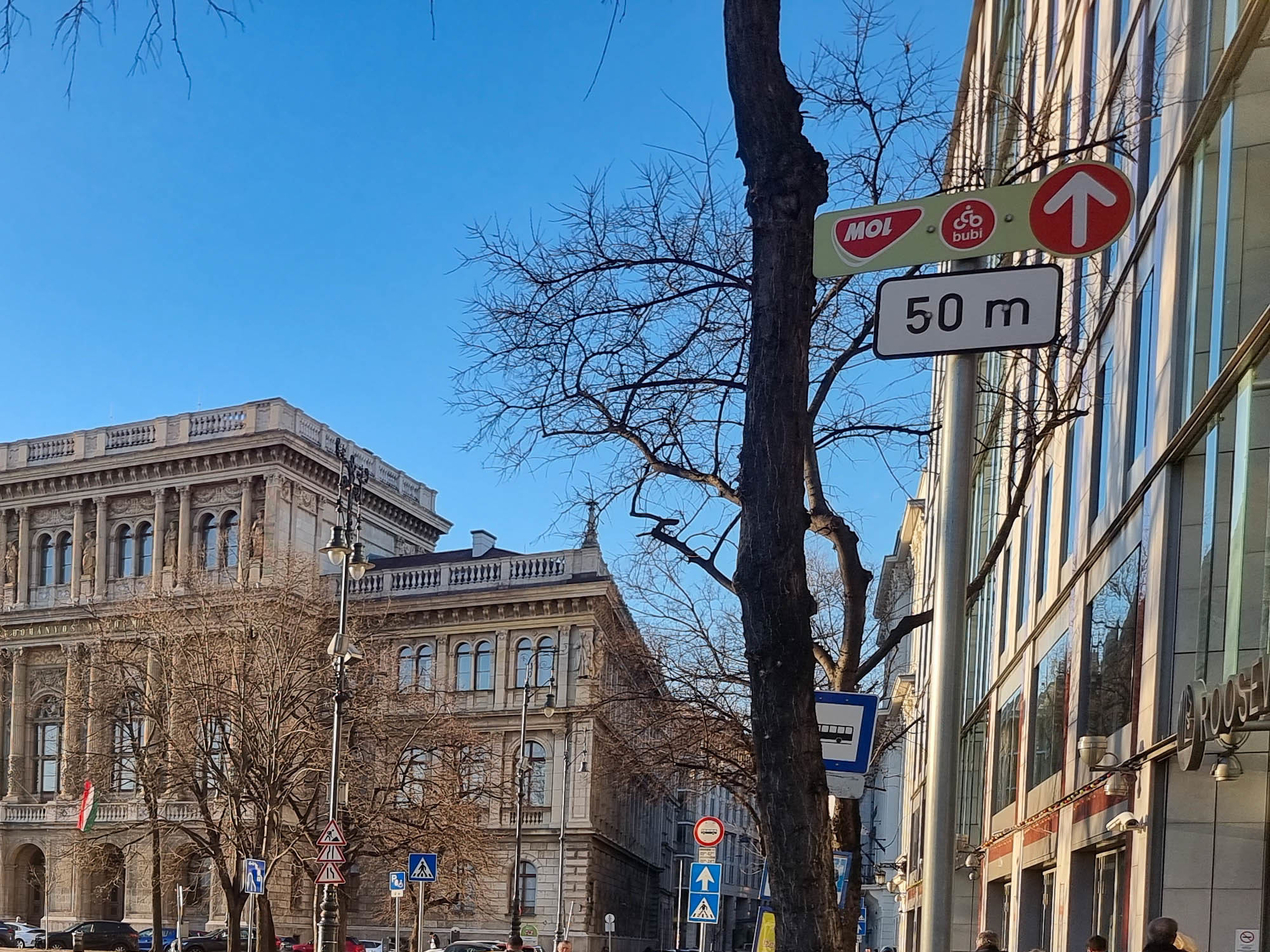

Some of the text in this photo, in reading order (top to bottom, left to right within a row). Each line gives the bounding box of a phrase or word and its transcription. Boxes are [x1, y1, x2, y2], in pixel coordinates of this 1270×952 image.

[843, 217, 893, 242] MOL
[952, 228, 983, 243] bubi
[906, 292, 1029, 335] 50 m
[1200, 653, 1270, 741] ROOSEV
